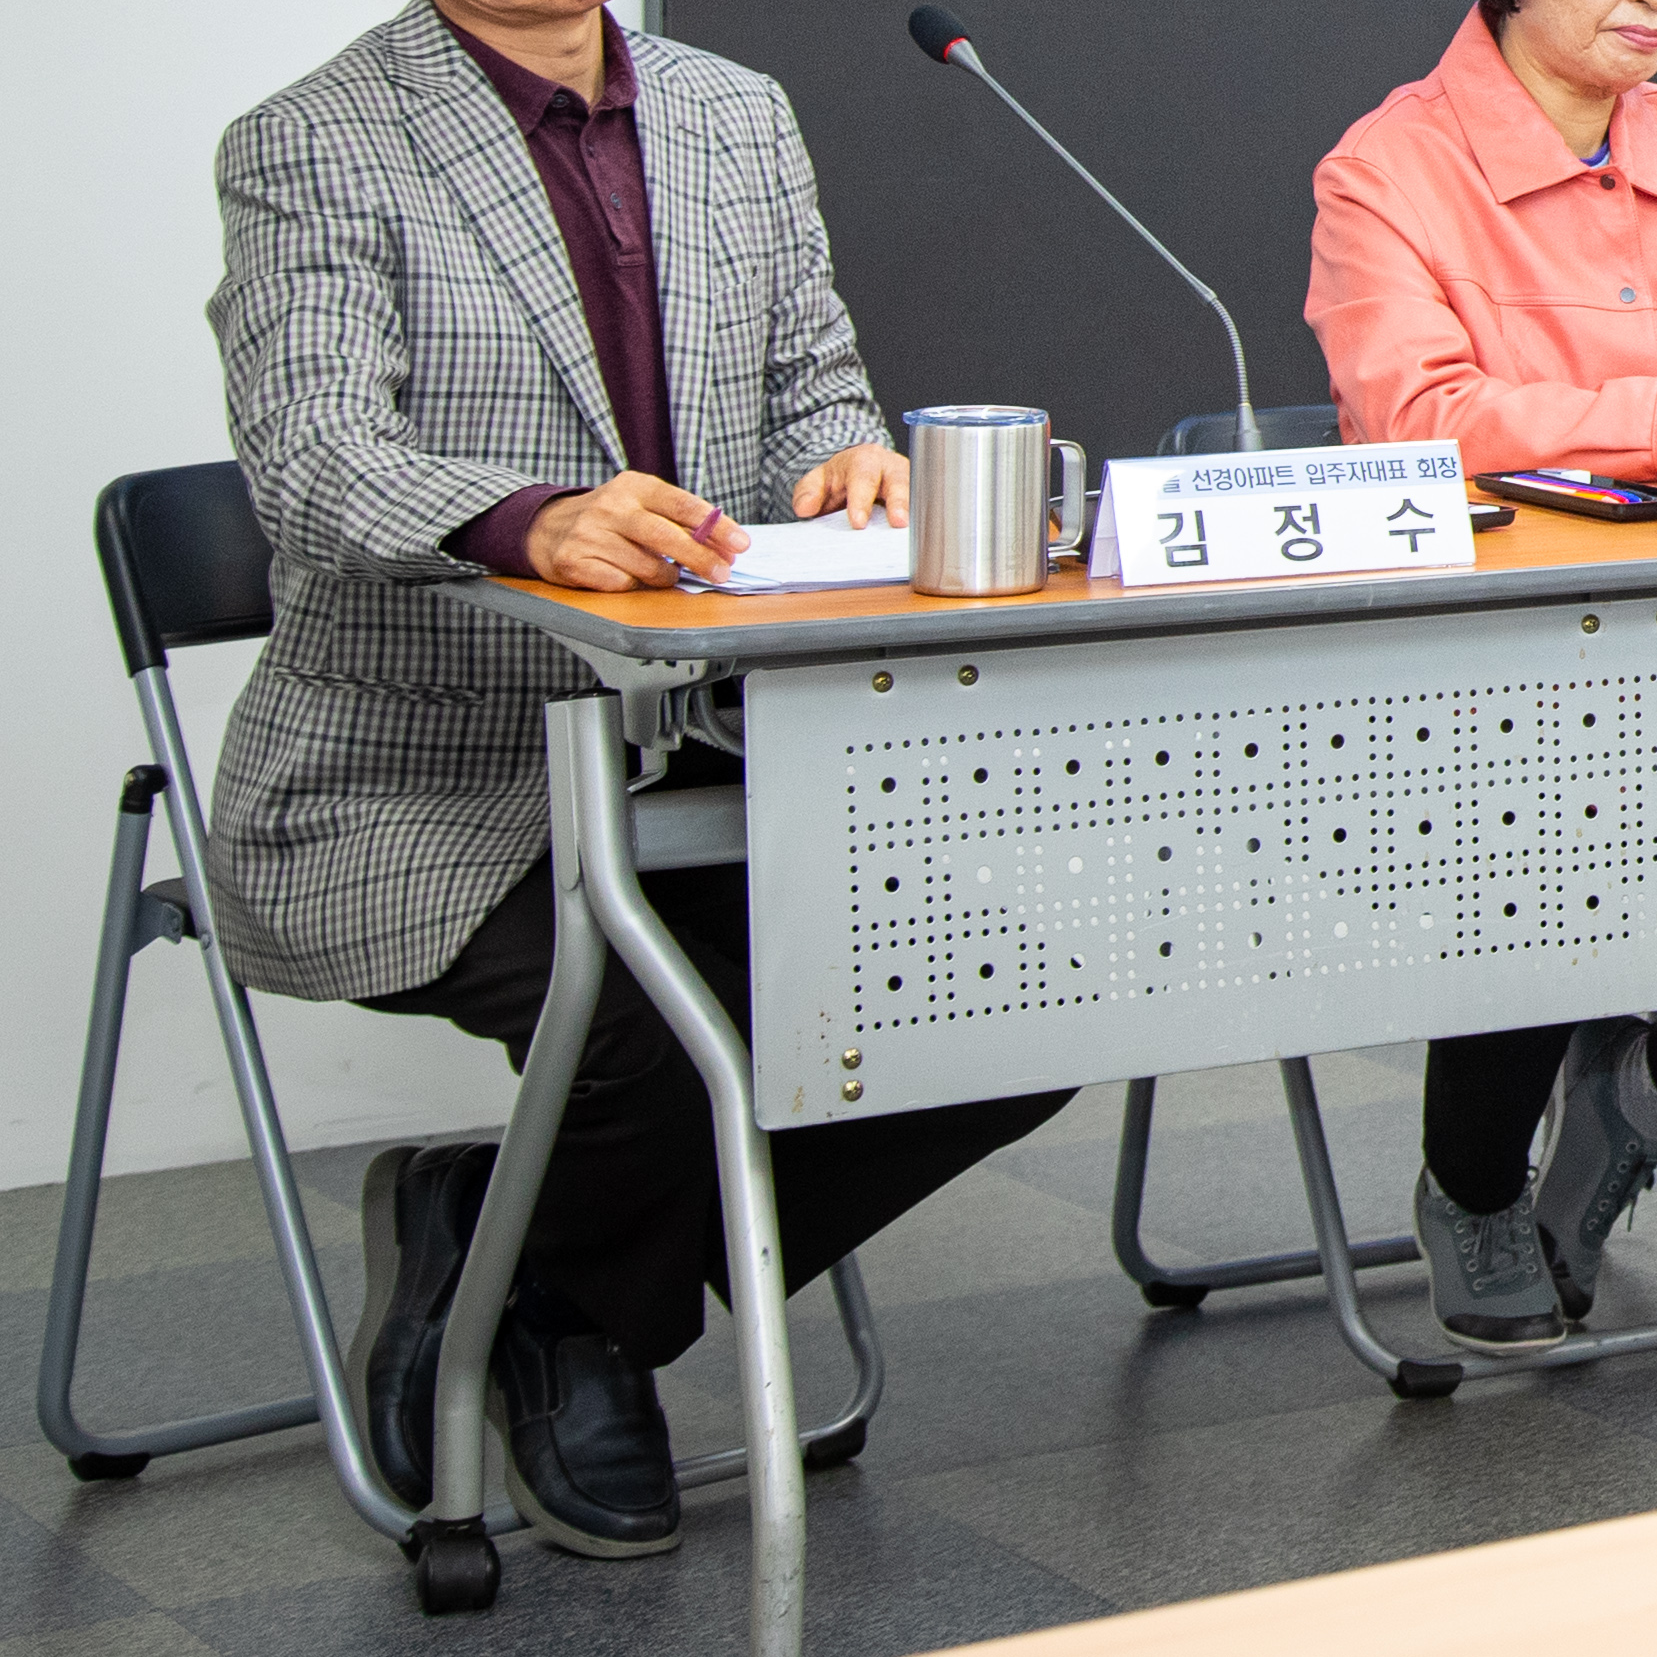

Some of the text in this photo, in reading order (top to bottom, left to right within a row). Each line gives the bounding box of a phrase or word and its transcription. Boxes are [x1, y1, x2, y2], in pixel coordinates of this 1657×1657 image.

[1192, 463, 1296, 491] 선경아파트
[1306, 459, 1408, 486] 입주자대표
[1417, 456, 1458, 480] 회장
